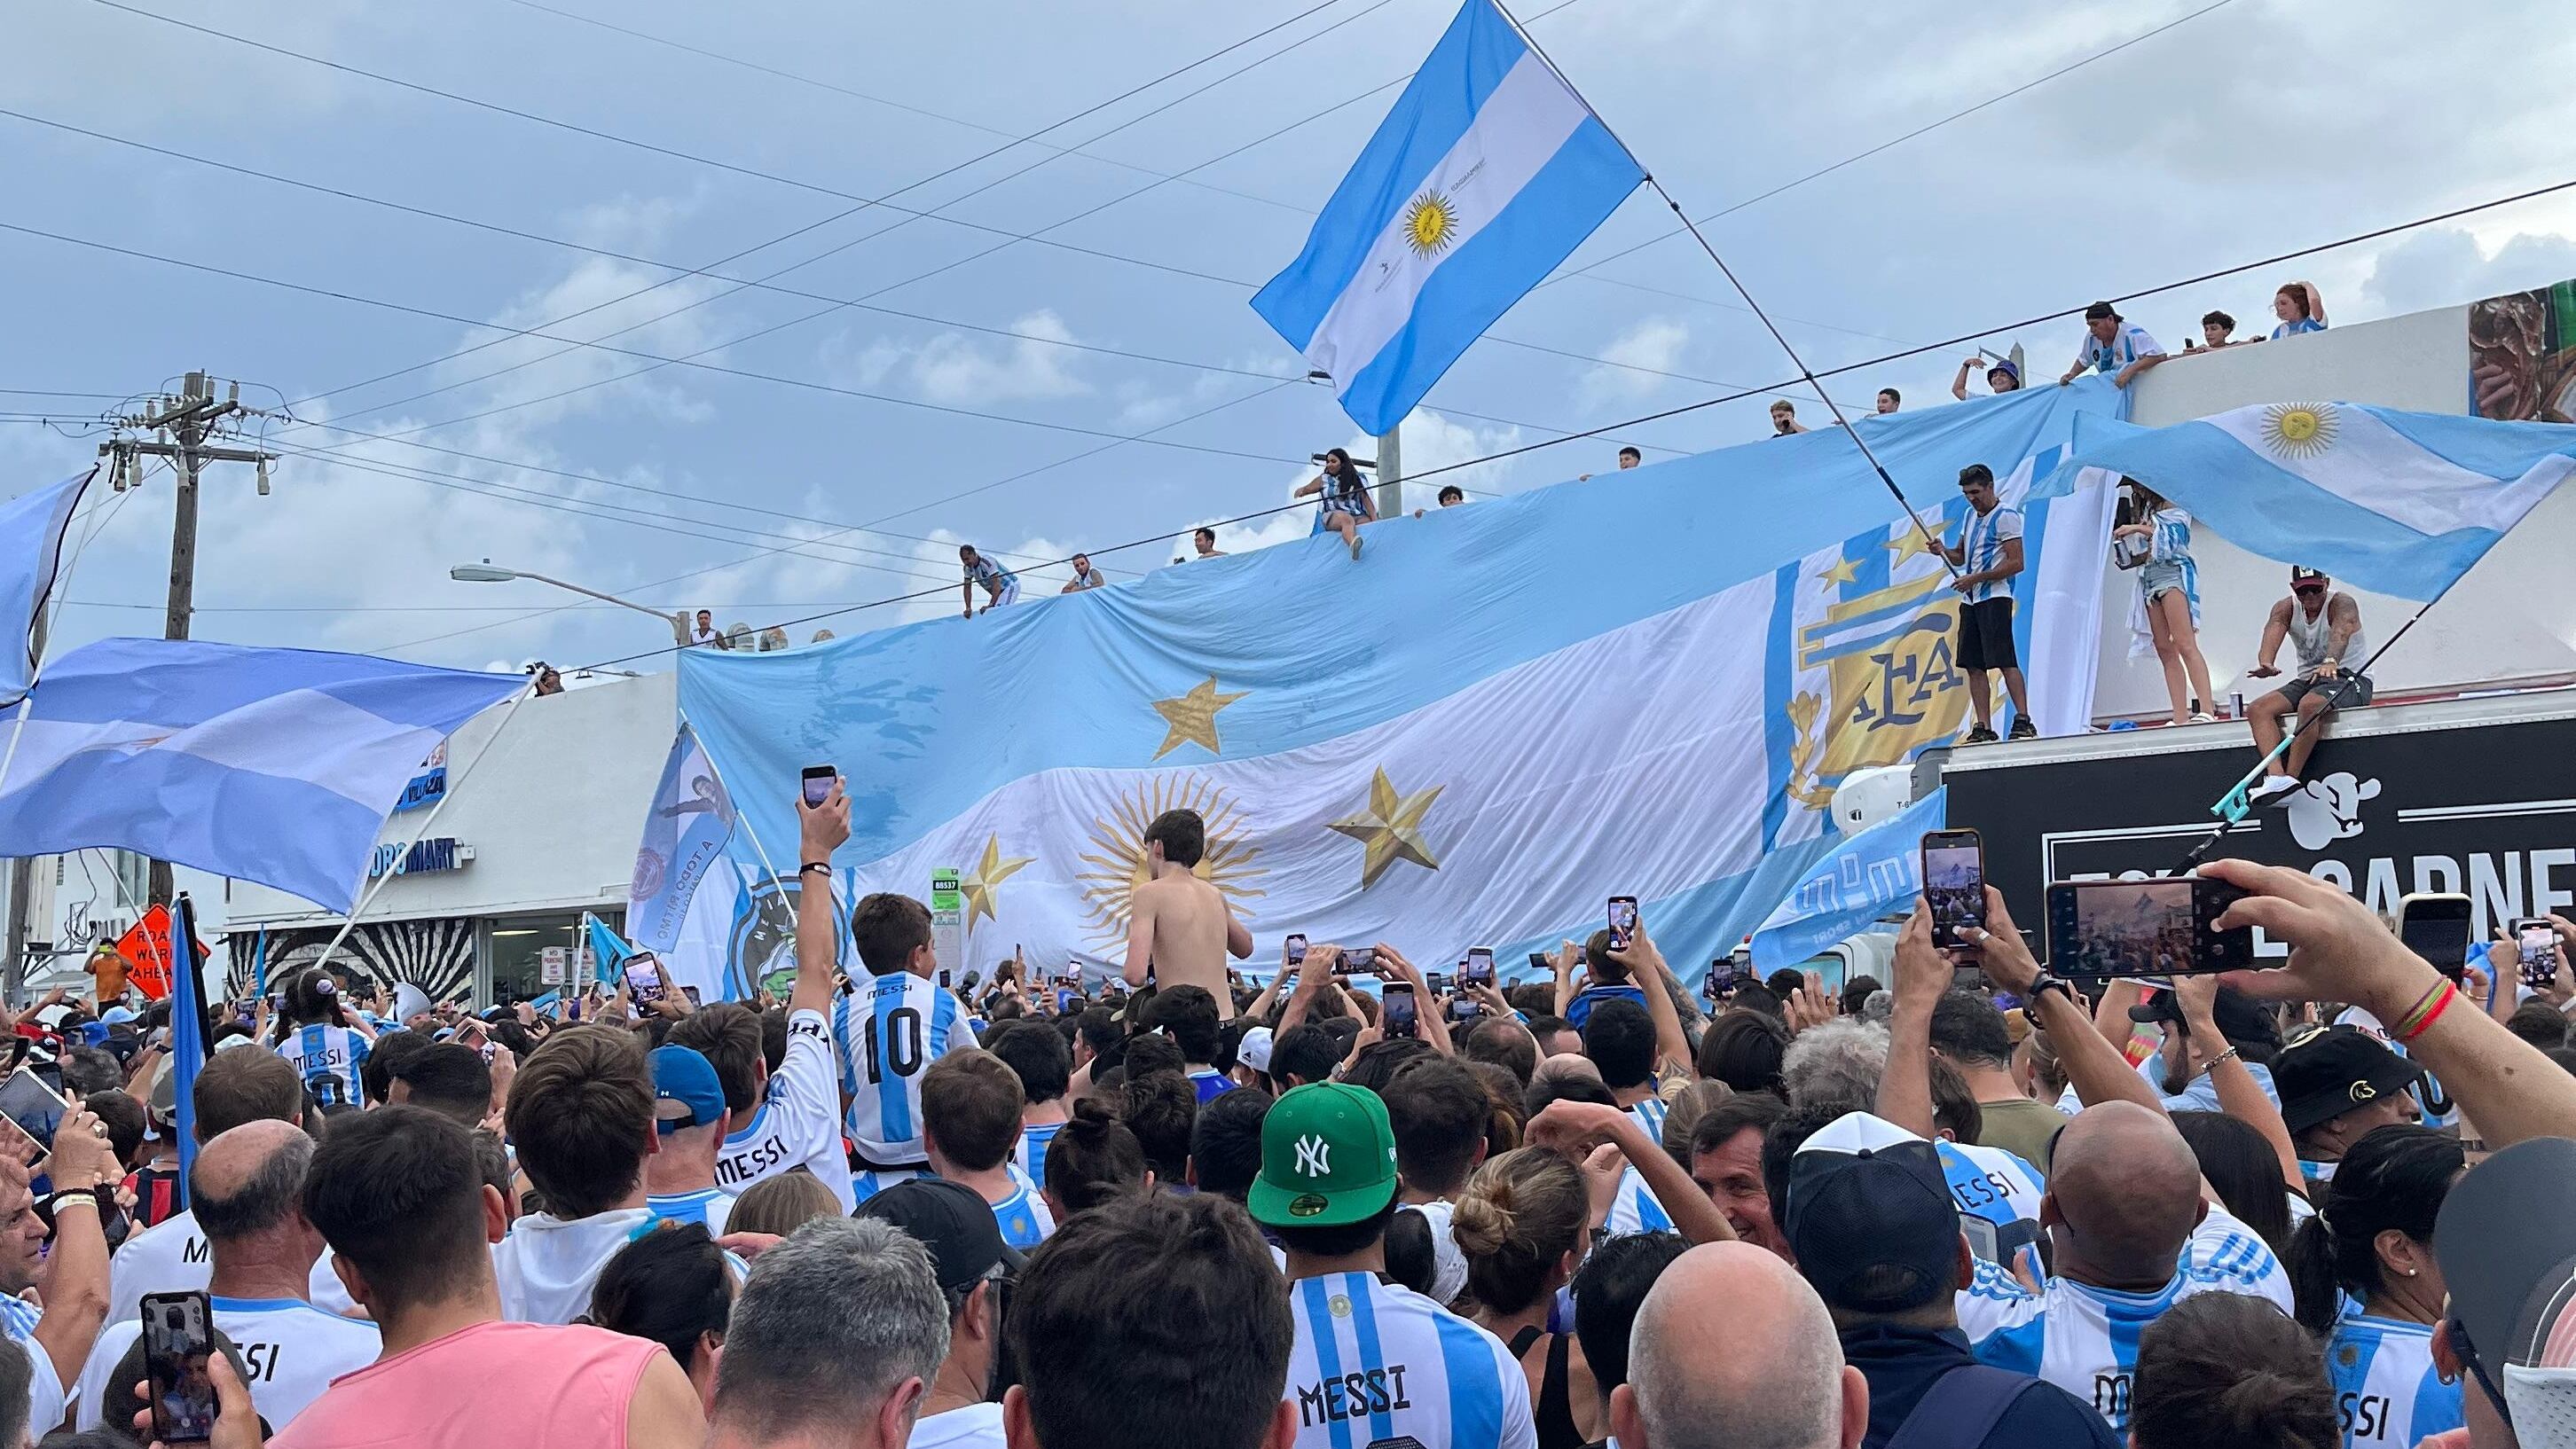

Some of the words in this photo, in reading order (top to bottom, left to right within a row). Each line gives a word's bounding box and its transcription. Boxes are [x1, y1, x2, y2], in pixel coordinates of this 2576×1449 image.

[136, 930, 171, 942] ROA
[132, 967, 172, 979] AHEA
[868, 984, 913, 999] MESSI
[293, 1048, 342, 1072] MESSI
[865, 1006, 923, 1085] 10
[713, 1134, 789, 1187] MESSI
[1293, 1133, 1331, 1178] NY
[1296, 1364, 1411, 1428] MESSI
